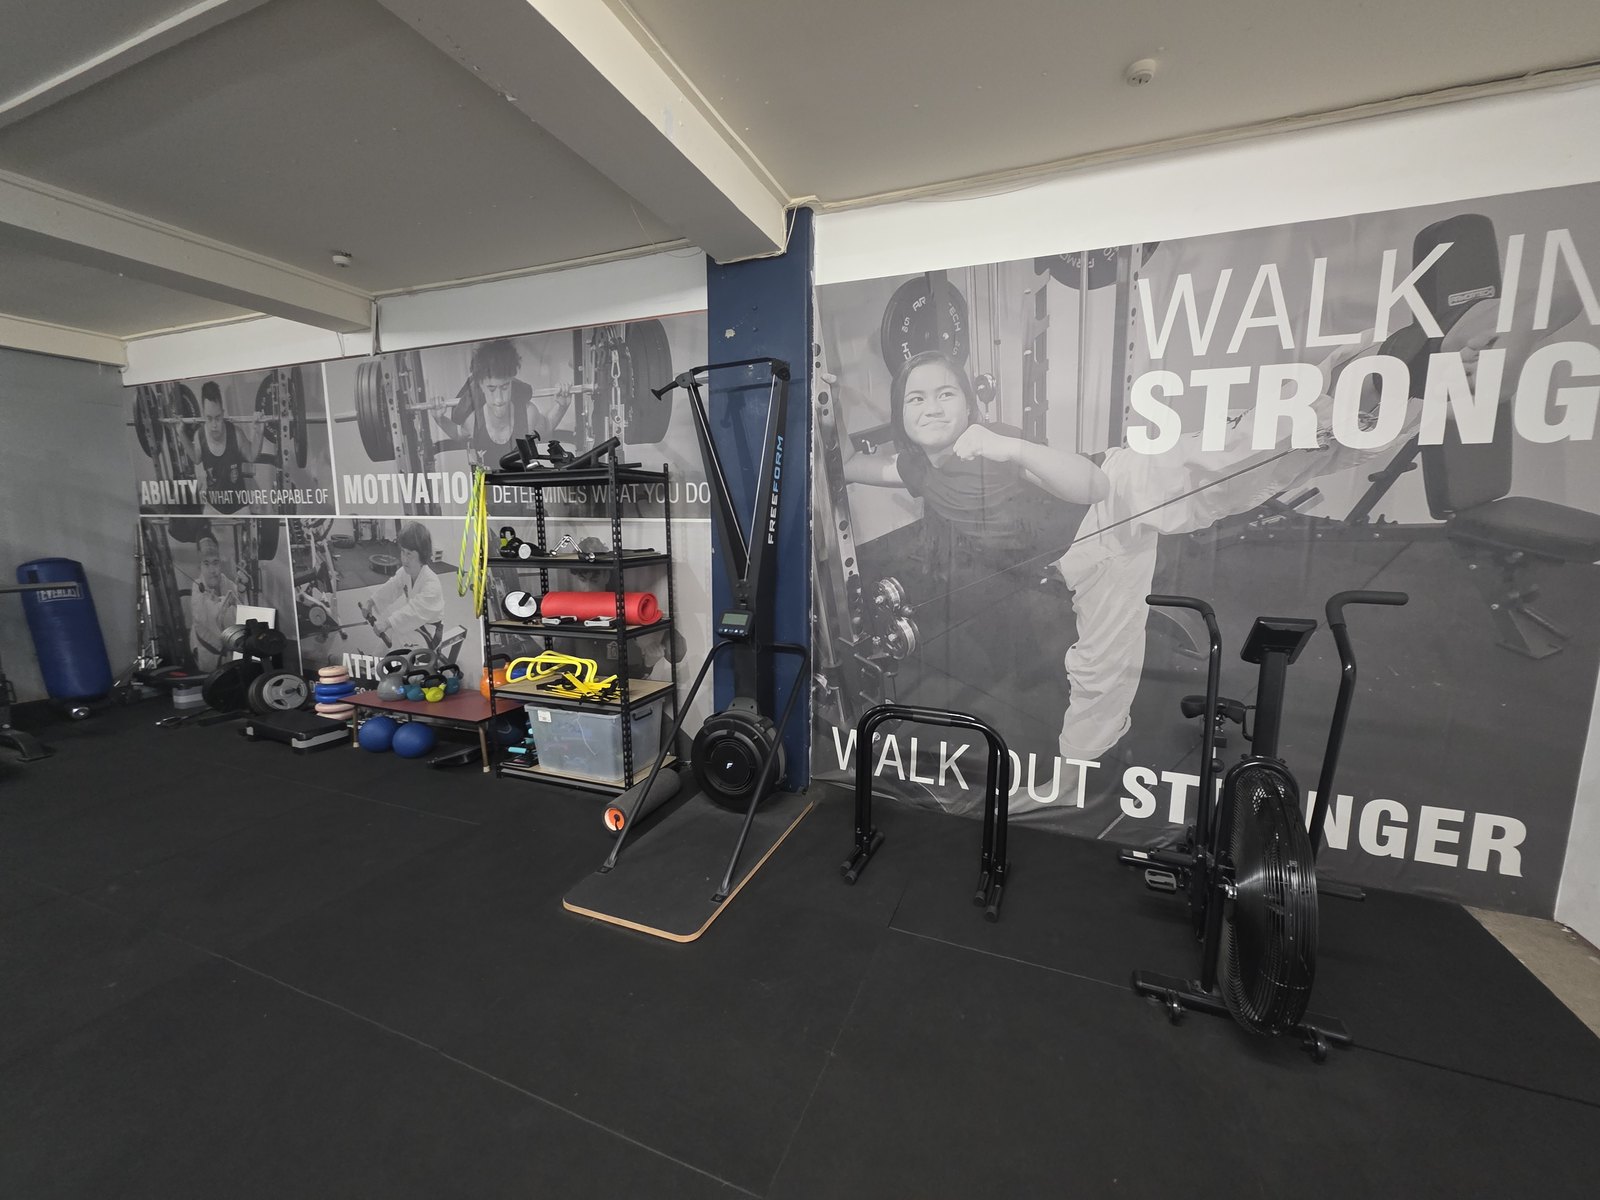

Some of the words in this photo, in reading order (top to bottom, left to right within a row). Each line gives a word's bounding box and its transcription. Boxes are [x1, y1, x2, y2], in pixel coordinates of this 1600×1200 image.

[1137, 242, 1454, 360] WALK
[1496, 228, 1600, 334] IN
[1126, 341, 1600, 456] STRONG
[141, 479, 199, 505] ABILITY
[208, 489, 234, 504] WHAT
[235, 489, 268, 505] YOU'RE
[270, 488, 313, 505] CAPABLE
[315, 488, 329, 505] OF
[643, 483, 680, 503] YOU
[685, 482, 711, 503] DO
[768, 435, 784, 545] FREEFORM
[832, 726, 970, 791] WALK
[1119, 765, 1528, 878] STNGER
